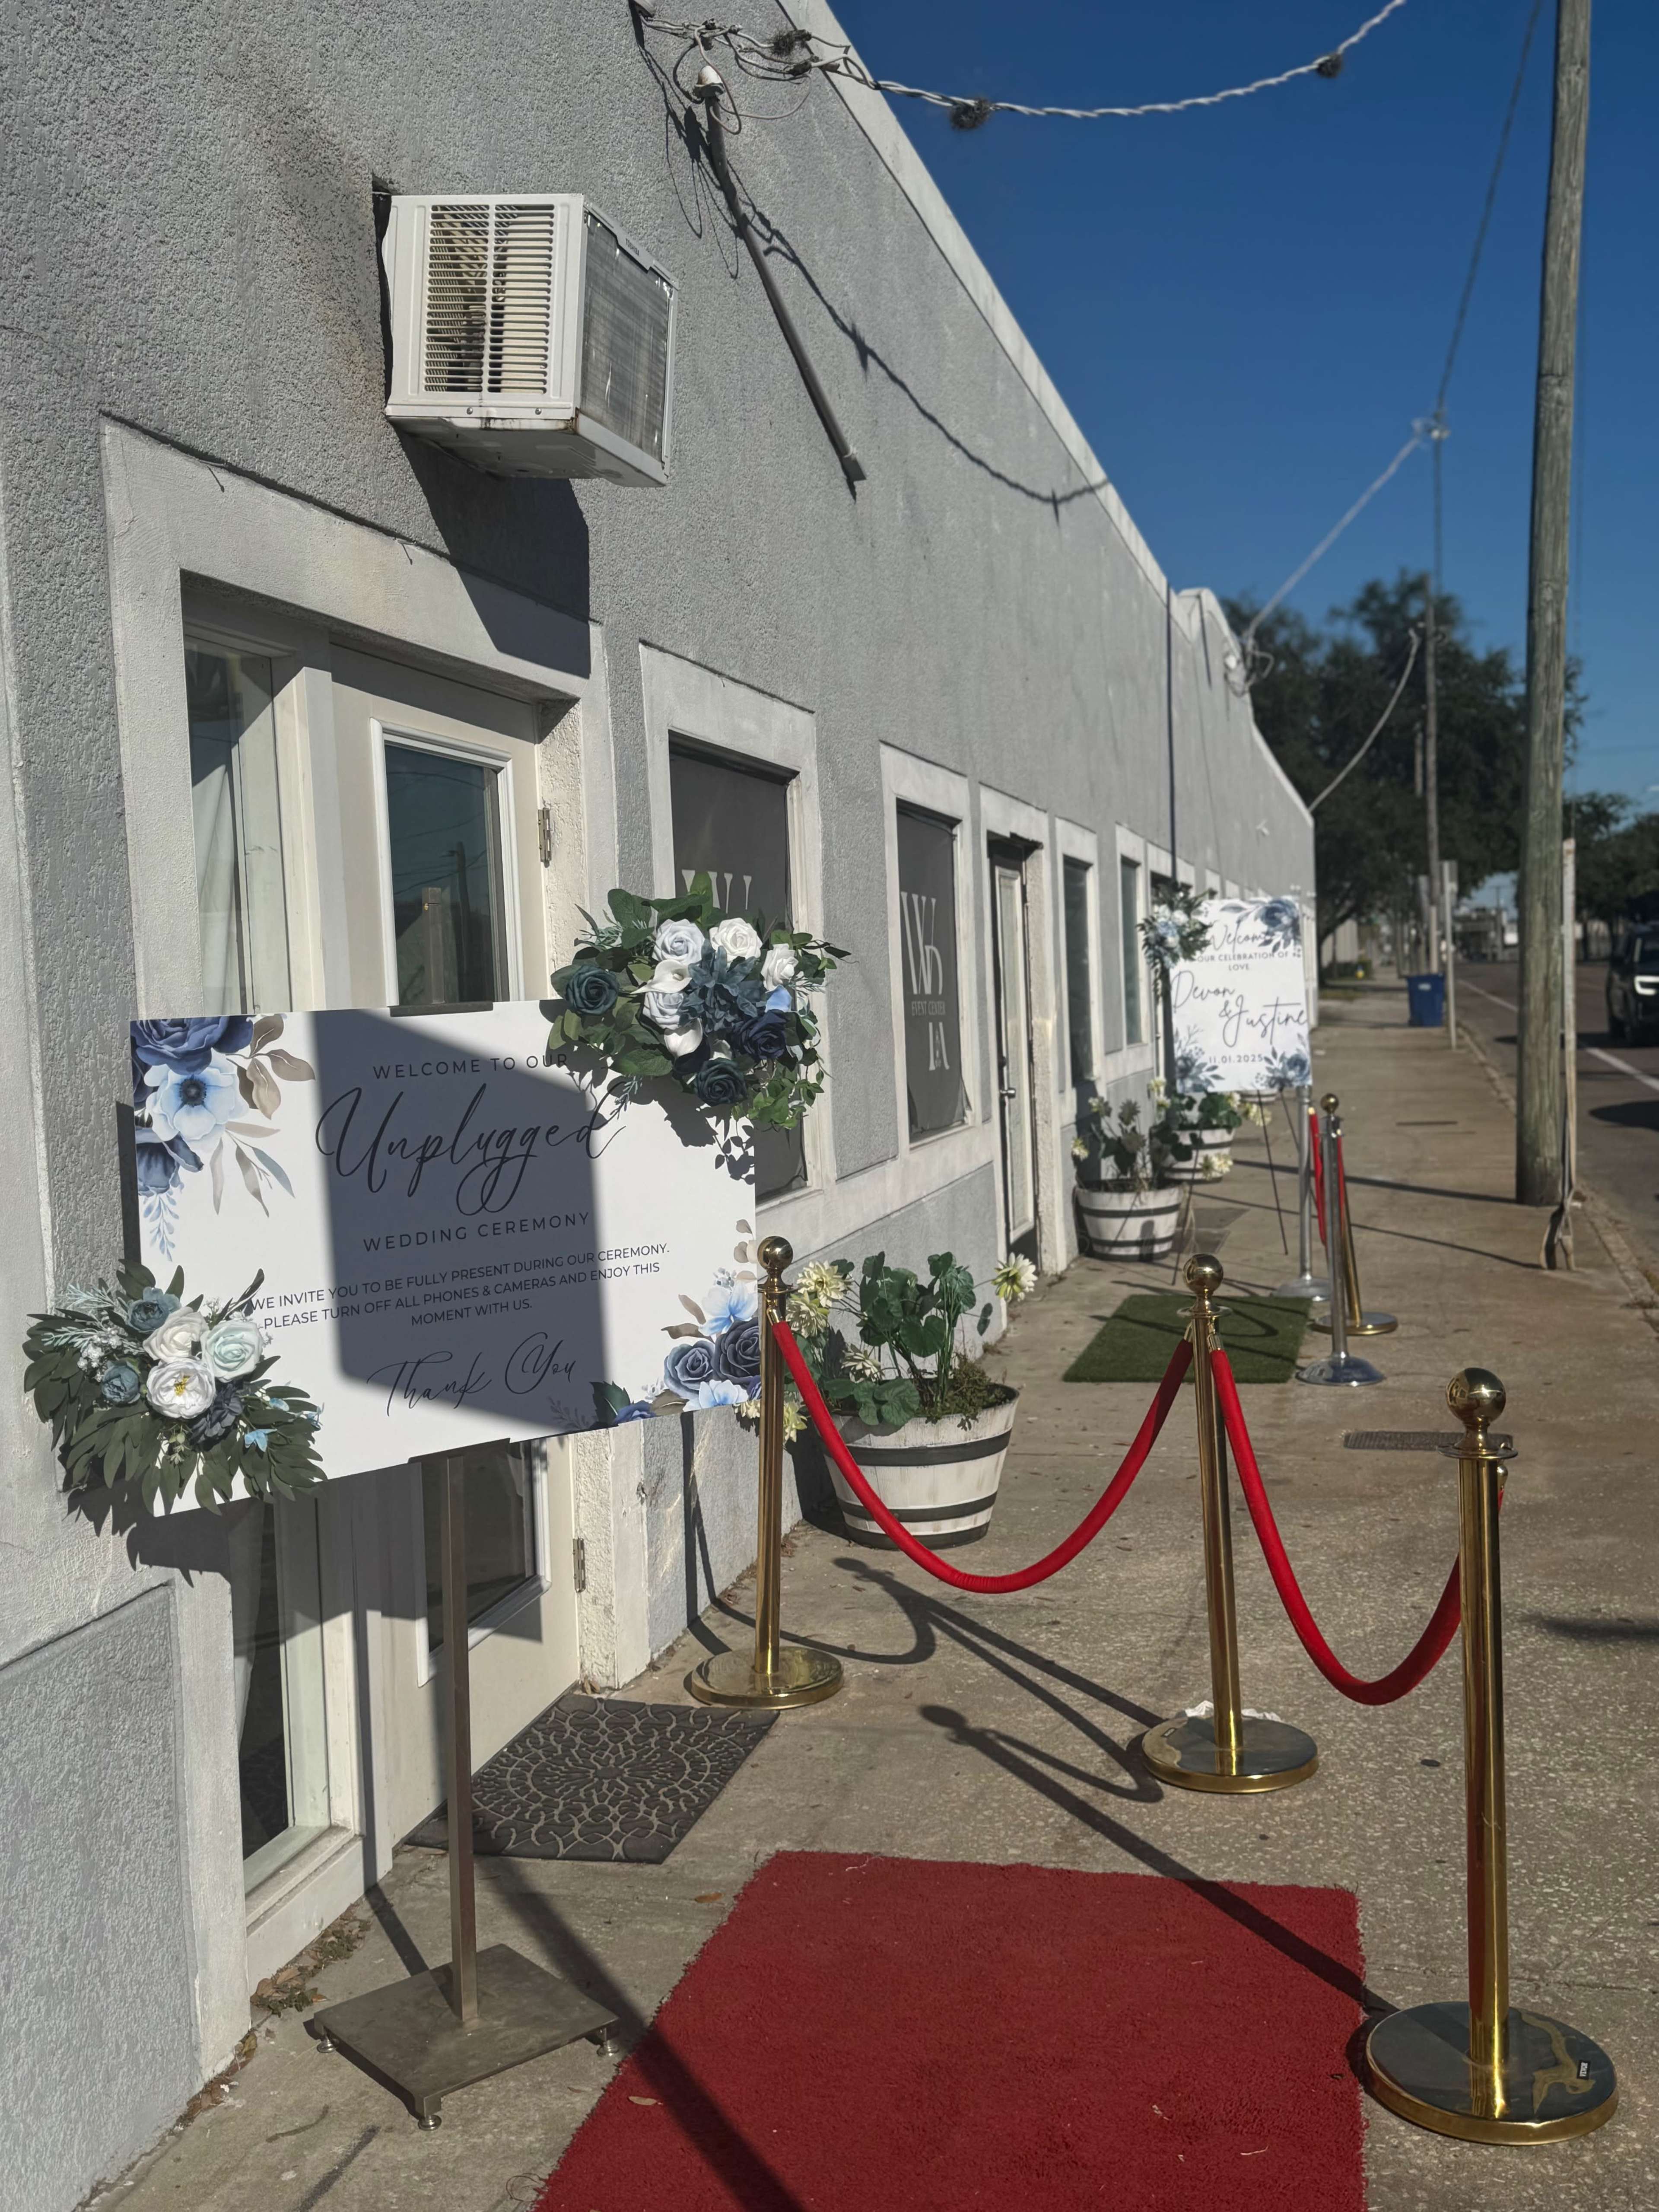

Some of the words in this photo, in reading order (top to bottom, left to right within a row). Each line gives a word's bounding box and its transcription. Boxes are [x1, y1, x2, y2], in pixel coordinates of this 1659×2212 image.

[1197, 954, 1214, 962] OUR
[1218, 952, 1274, 961] CELEBRATION
[1171, 970, 1235, 1013] Devon
[1223, 994, 1308, 1047] Justine
[373, 1059, 481, 1079] WELCOME
[490, 1057, 516, 1071] TO
[526, 1053, 568, 1068] OUR
[315, 1081, 626, 1216] Unplugged
[363, 1227, 467, 1252] WEDDING
[478, 1212, 589, 1237] CEREMONY
[250, 1297, 275, 1311] WE
[279, 1289, 324, 1307] INVITE
[328, 1285, 358, 1299] YOU
[362, 1282, 381, 1294] TO
[385, 1279, 403, 1291] BE
[407, 1272, 448, 1288] FULLY
[451, 1264, 511, 1282] PRESENT
[514, 1257, 564, 1273] DURING
[567, 1253, 594, 1266] OUR
[597, 1243, 670, 1261] CEREMONY.
[264, 1311, 318, 1330] PLEASE
[322, 1304, 359, 1320] TURN
[364, 1299, 392, 1314] OFF
[395, 1295, 420, 1309] ALL
[424, 1287, 479, 1305] PHONES
[483, 1285, 491, 1296] &
[494, 1276, 556, 1294] CAMERAS
[559, 1272, 587, 1285] AND
[591, 1266, 630, 1281] ENJOY
[633, 1262, 660, 1275] THIS
[411, 1307, 472, 1326] MOMENT
[475, 1301, 509, 1316] WITH
[513, 1298, 533, 1310] US.
[367, 1351, 492, 1416] Thank
[505, 1332, 576, 1394] You
